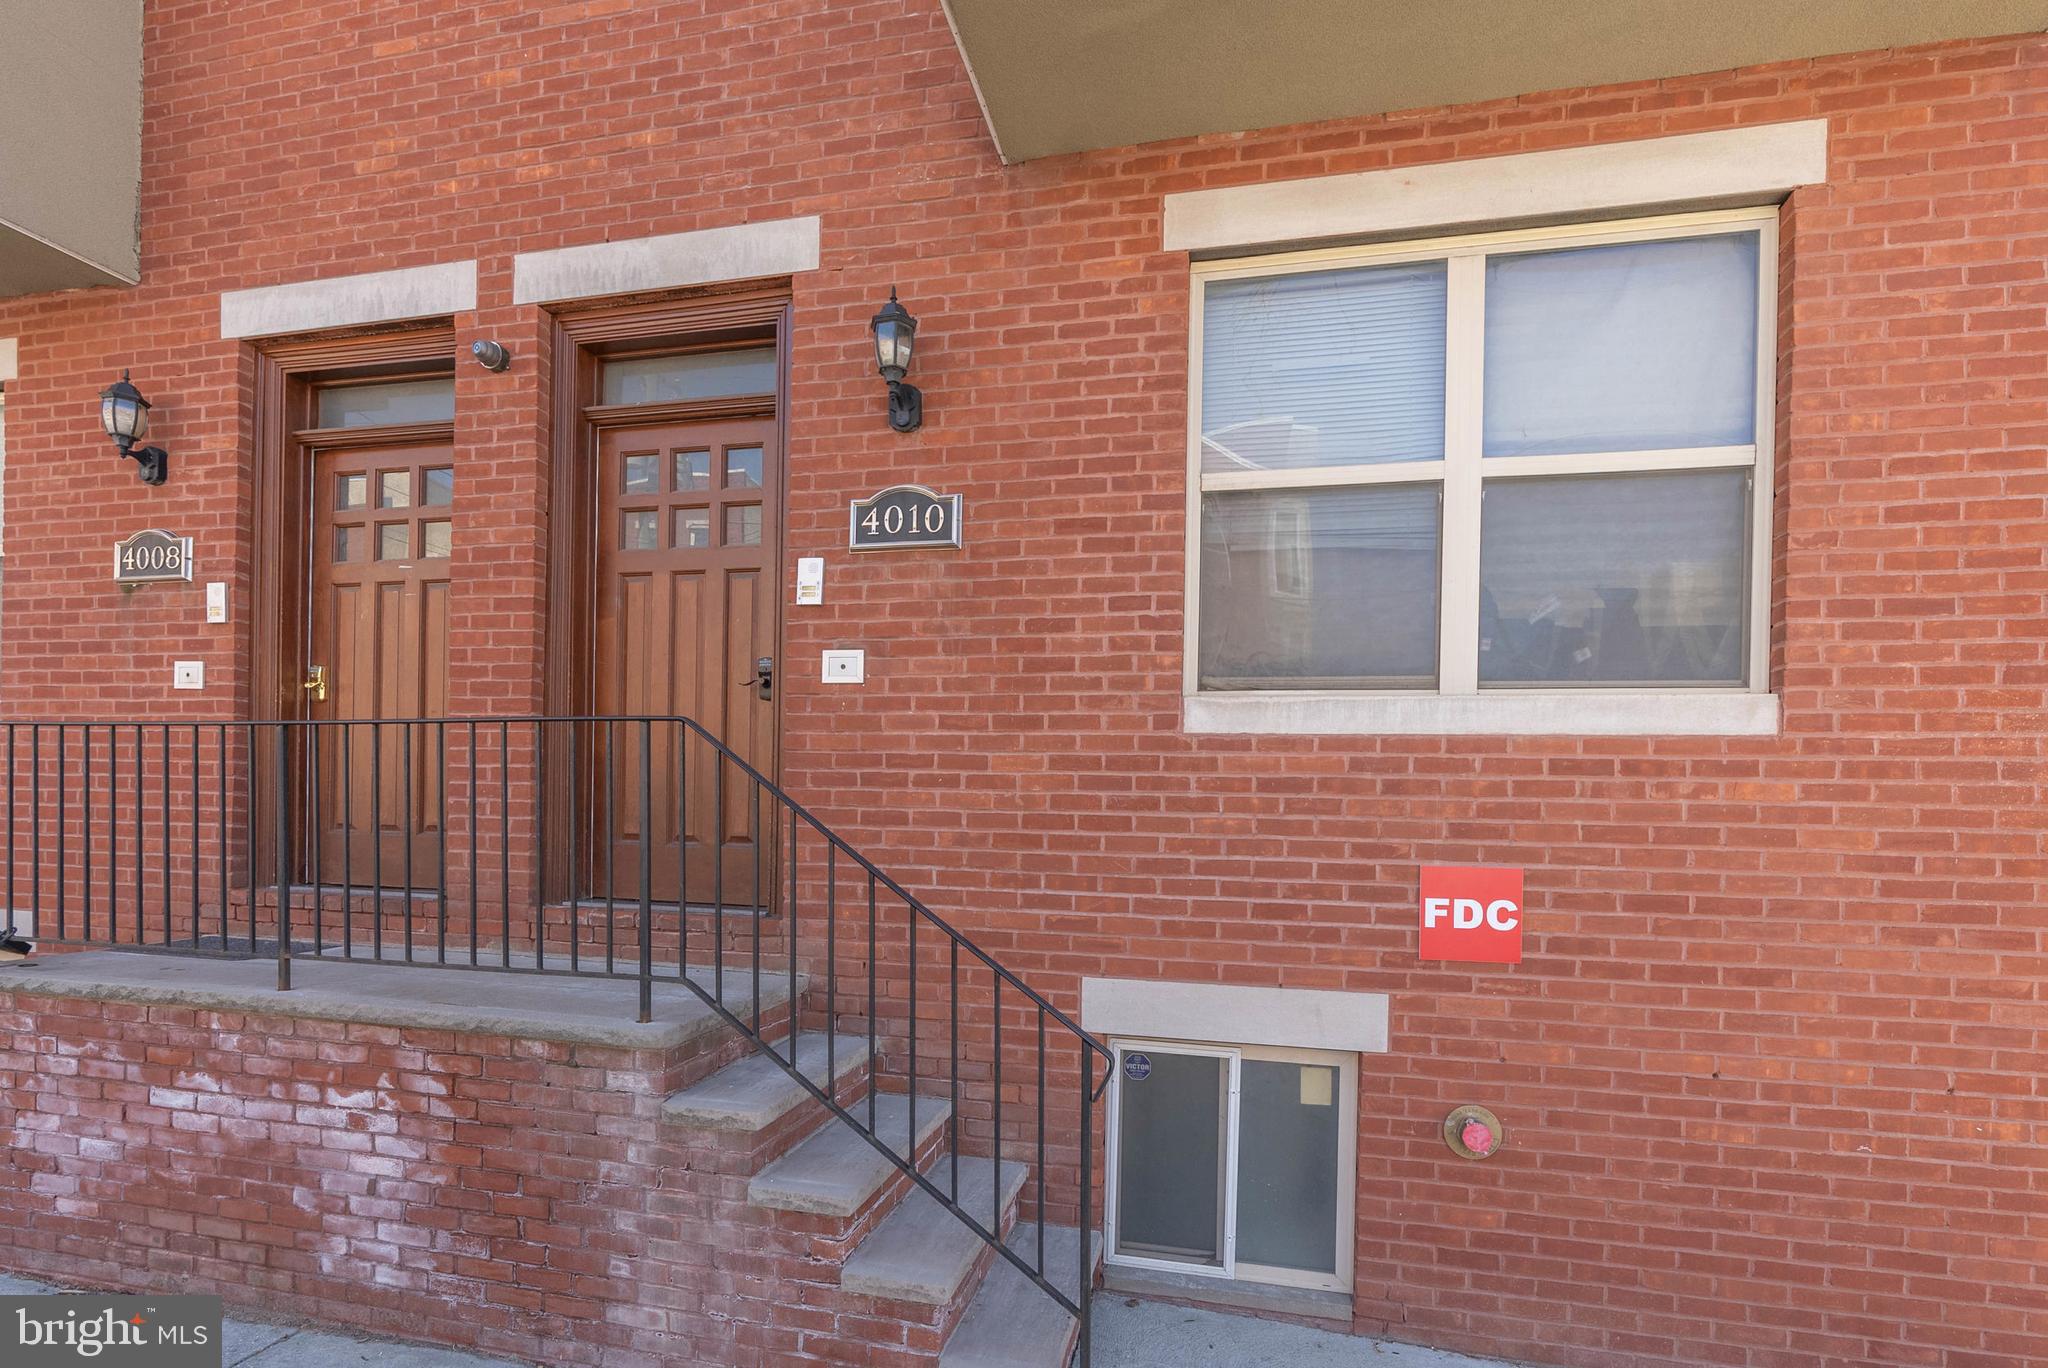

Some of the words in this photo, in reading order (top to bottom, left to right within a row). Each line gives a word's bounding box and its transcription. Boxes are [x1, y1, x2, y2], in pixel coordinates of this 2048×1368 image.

[861, 503, 945, 535] 4010
[122, 545, 181, 571] 4008
[1424, 897, 1519, 932] FDC
[1125, 1062, 1150, 1071] VICTOR
